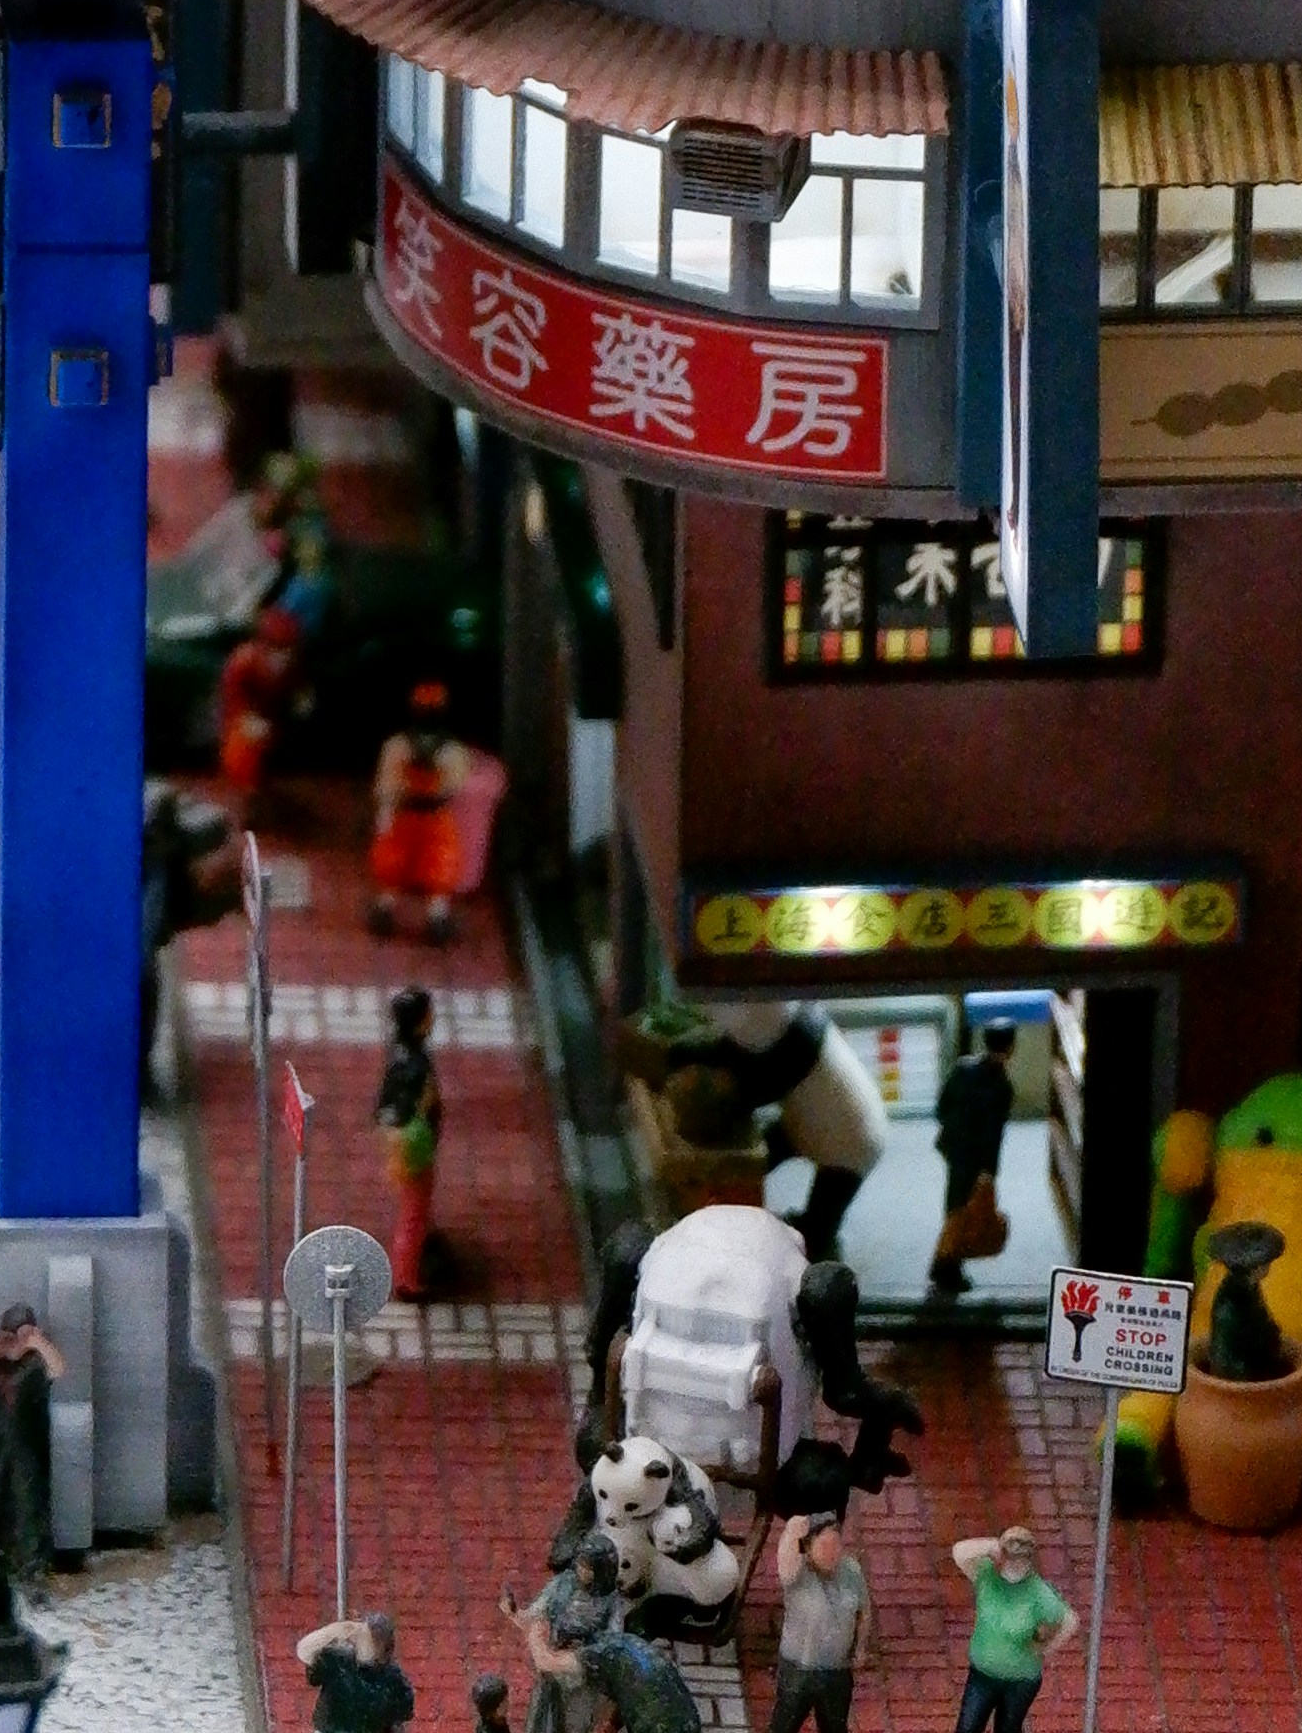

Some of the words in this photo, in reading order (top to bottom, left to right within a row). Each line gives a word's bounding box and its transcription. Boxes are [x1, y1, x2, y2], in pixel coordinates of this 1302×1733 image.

[1115, 1328, 1167, 1348] STOP
[1106, 1346, 1175, 1363] CHILDREN
[1104, 1358, 1174, 1377] CROSSING
